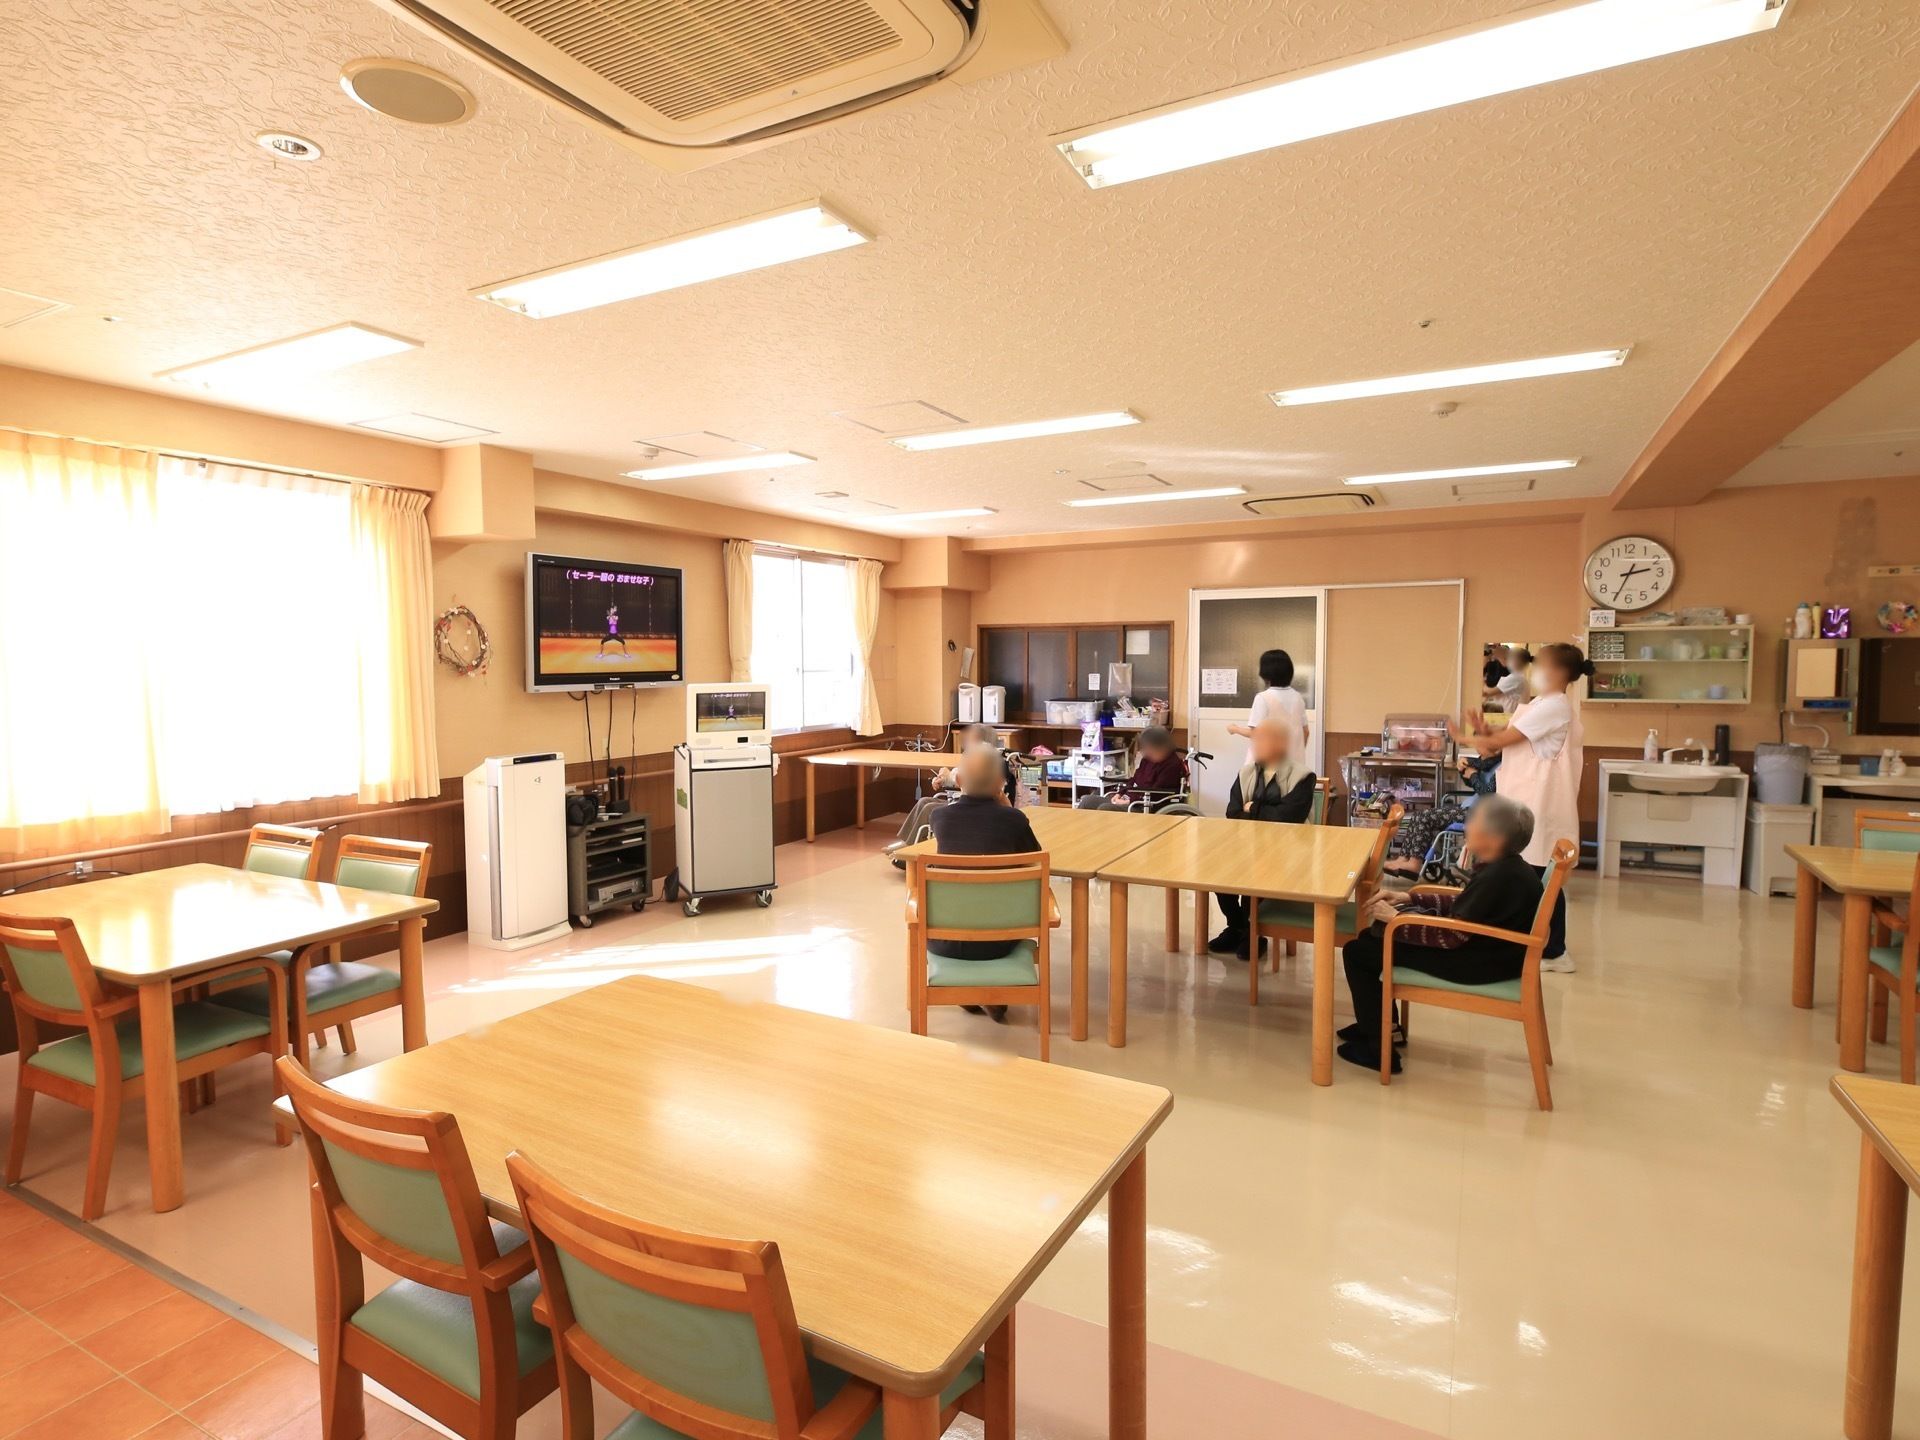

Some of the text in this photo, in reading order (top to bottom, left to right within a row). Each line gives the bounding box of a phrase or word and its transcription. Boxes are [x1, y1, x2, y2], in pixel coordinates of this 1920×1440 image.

[1611, 548, 1620, 558] 11
[1624, 544, 1636, 554] 12
[1600, 557, 1610, 567] 10
[1652, 555, 1660, 565] 2
[1594, 570, 1602, 580] 9
[1656, 567, 1664, 577] 3
[1600, 584, 1607, 593] 8
[1651, 581, 1659, 591] 4
[1624, 594, 1632, 604] 6
[1640, 591, 1647, 600] 5
